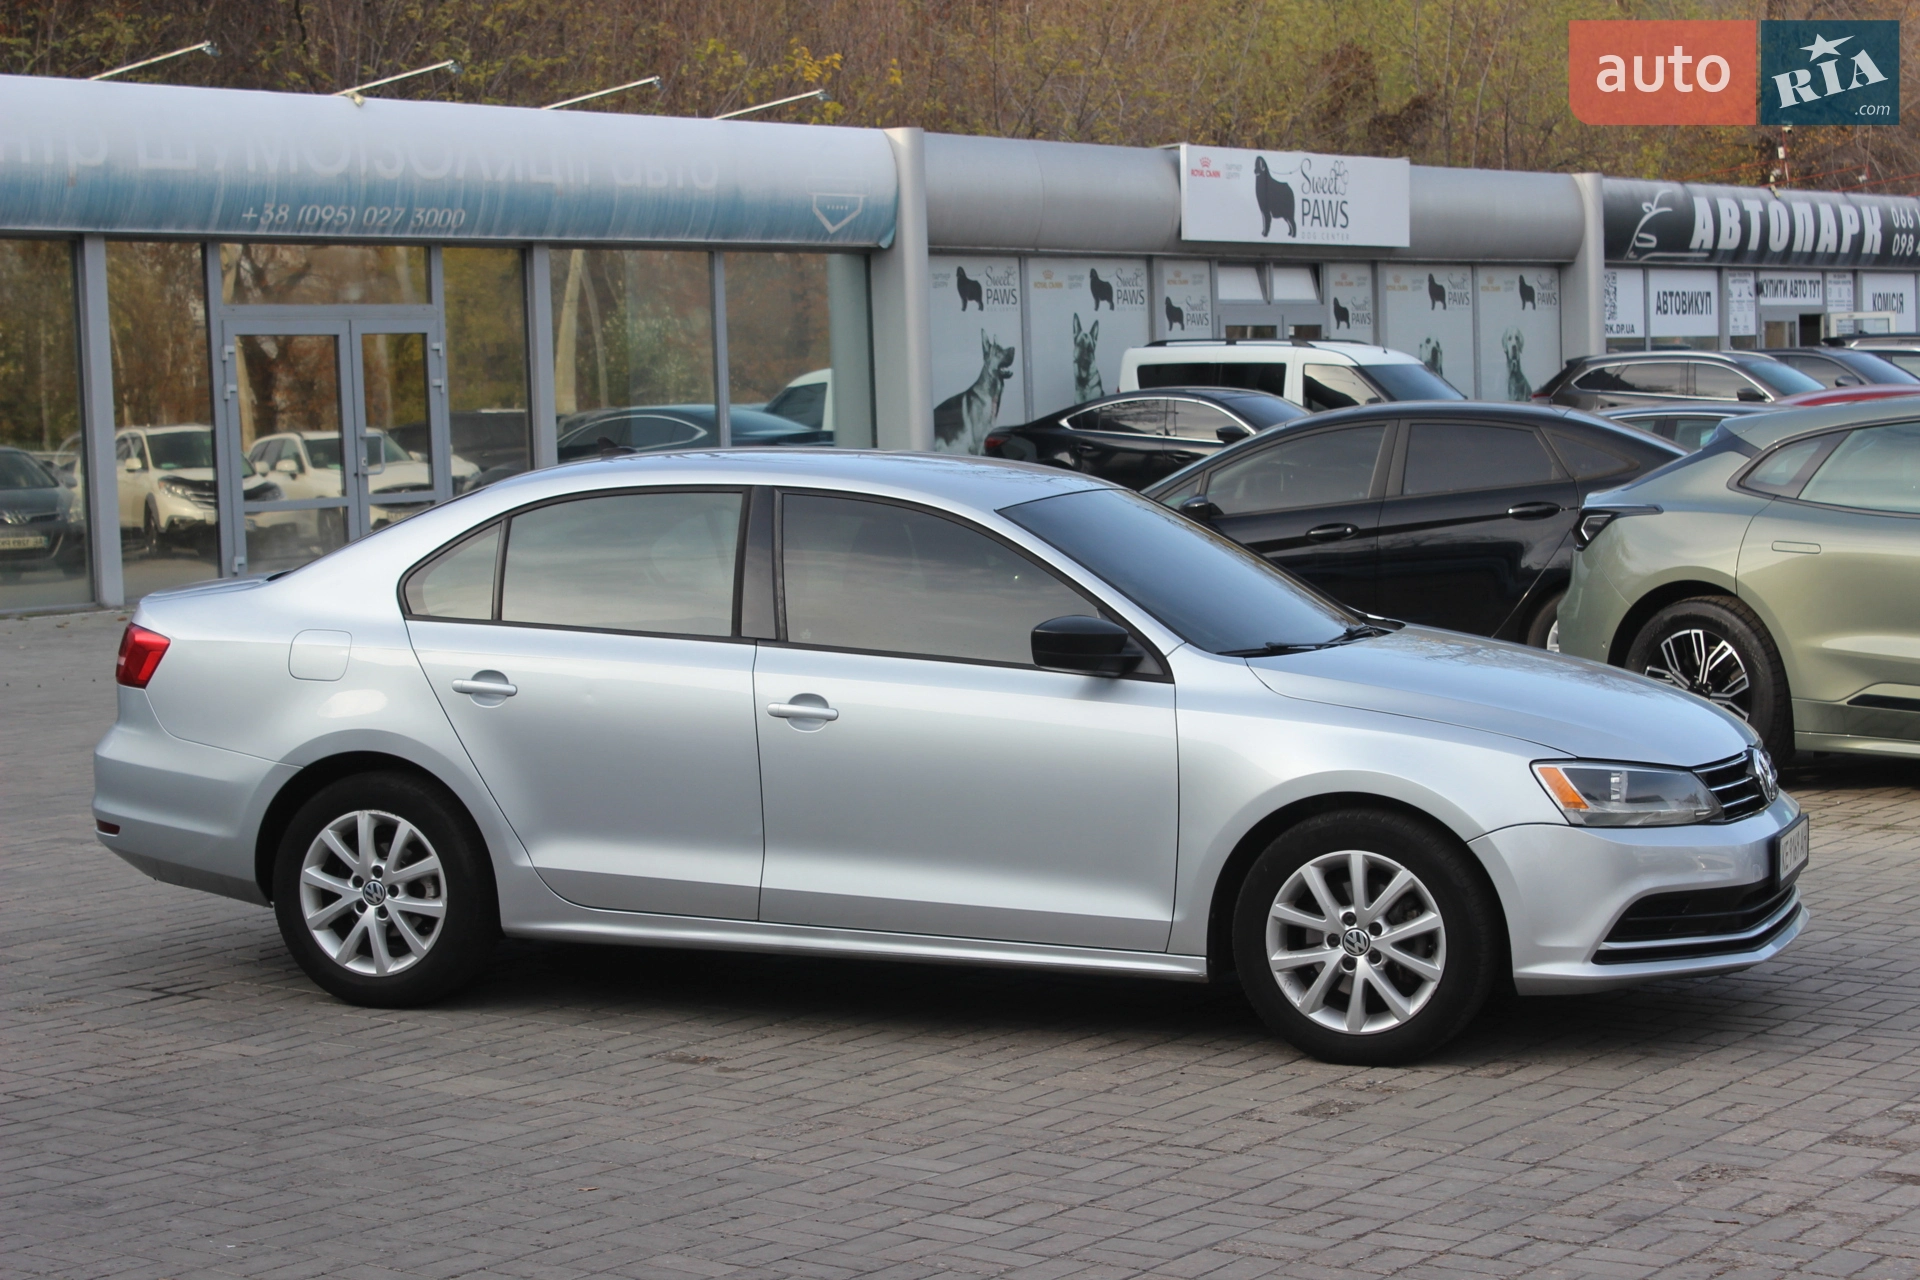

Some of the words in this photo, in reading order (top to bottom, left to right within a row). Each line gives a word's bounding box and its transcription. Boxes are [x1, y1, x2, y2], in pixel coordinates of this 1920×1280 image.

[1301, 158, 1346, 195] Sweet
[241, 203, 290, 226] +38
[298, 204, 355, 228] (095)
[363, 206, 405, 228] 027
[411, 207, 466, 229] 3000
[1301, 198, 1349, 229] PAWS
[1891, 207, 1914, 229] 066
[1688, 196, 1883, 255] АВТОПАРК
[1891, 233, 1914, 257] 098
[986, 288, 1018, 305] PAWS
[1116, 289, 1145, 305] PAWS
[1448, 291, 1470, 306] PAWS
[1537, 292, 1557, 306] PAWS
[1789, 280, 1807, 298] АВТО
[1808, 280, 1821, 298] ТУТ
[1656, 290, 1712, 315] АВТОВИКУП
[1872, 292, 1904, 314] КОМІСІЯ
[1186, 313, 1209, 326] PAWS
[1351, 312, 1371, 325] PAWS
